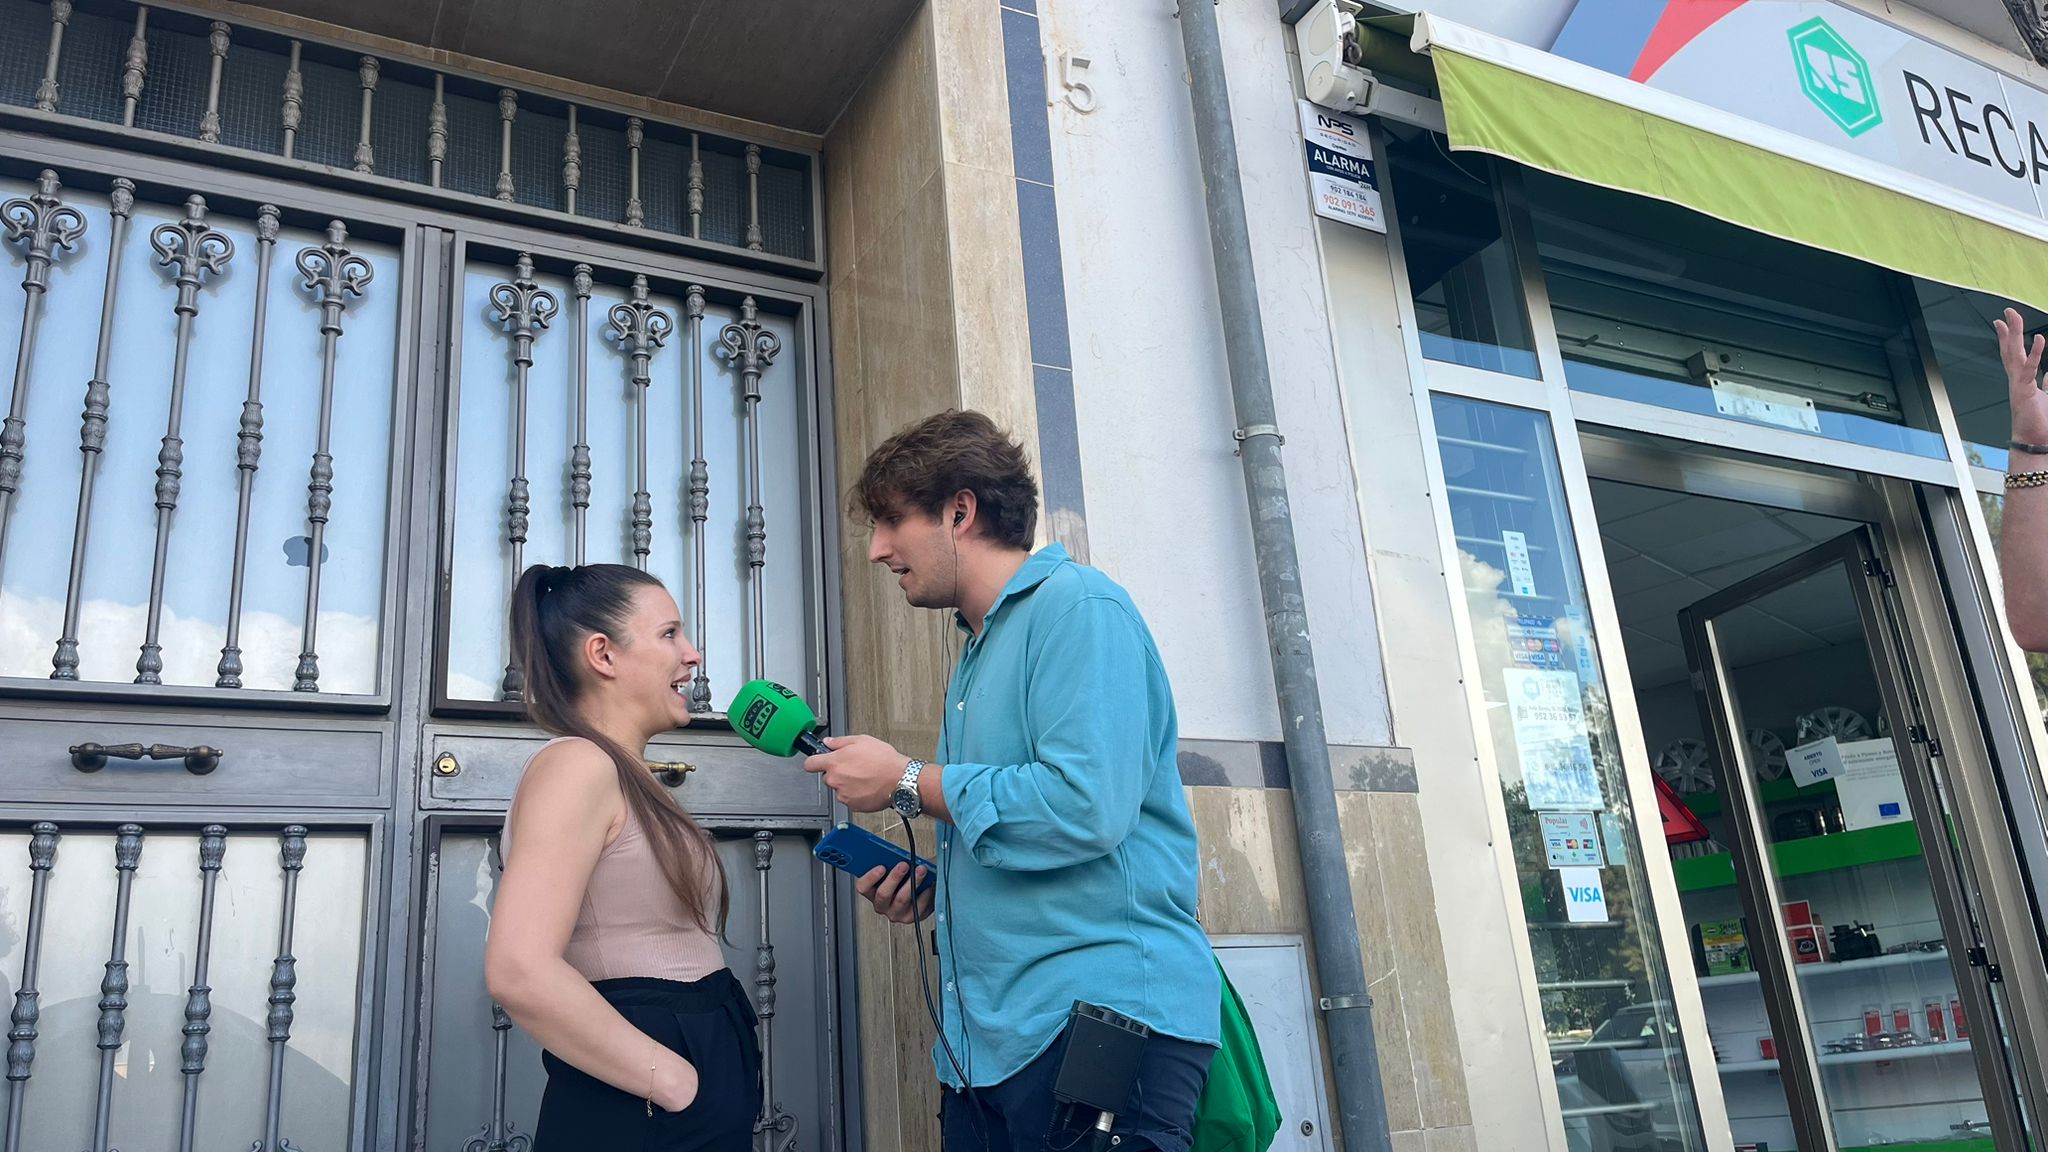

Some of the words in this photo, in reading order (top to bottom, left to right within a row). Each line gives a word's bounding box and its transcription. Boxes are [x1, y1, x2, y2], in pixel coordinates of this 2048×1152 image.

[1042, 46, 1097, 115] 15
[1317, 114, 1354, 136] NPS
[1902, 69, 2048, 185] RECA
[1314, 148, 1370, 178] ALARMA
[1330, 185, 1342, 194] 902
[1343, 189, 1354, 198] 184
[1355, 192, 1367, 201] 184
[1323, 194, 1340, 206] 902
[1341, 199, 1357, 212] 091
[1359, 204, 1376, 217] 365
[745, 701, 763, 726] ONDA
[753, 706, 771, 731] CERO
[1804, 751, 1823, 761] ABIERTO
[1811, 767, 1829, 778] VISA
[1545, 816, 1568, 826] Popular
[1567, 886, 1602, 902] VISA
